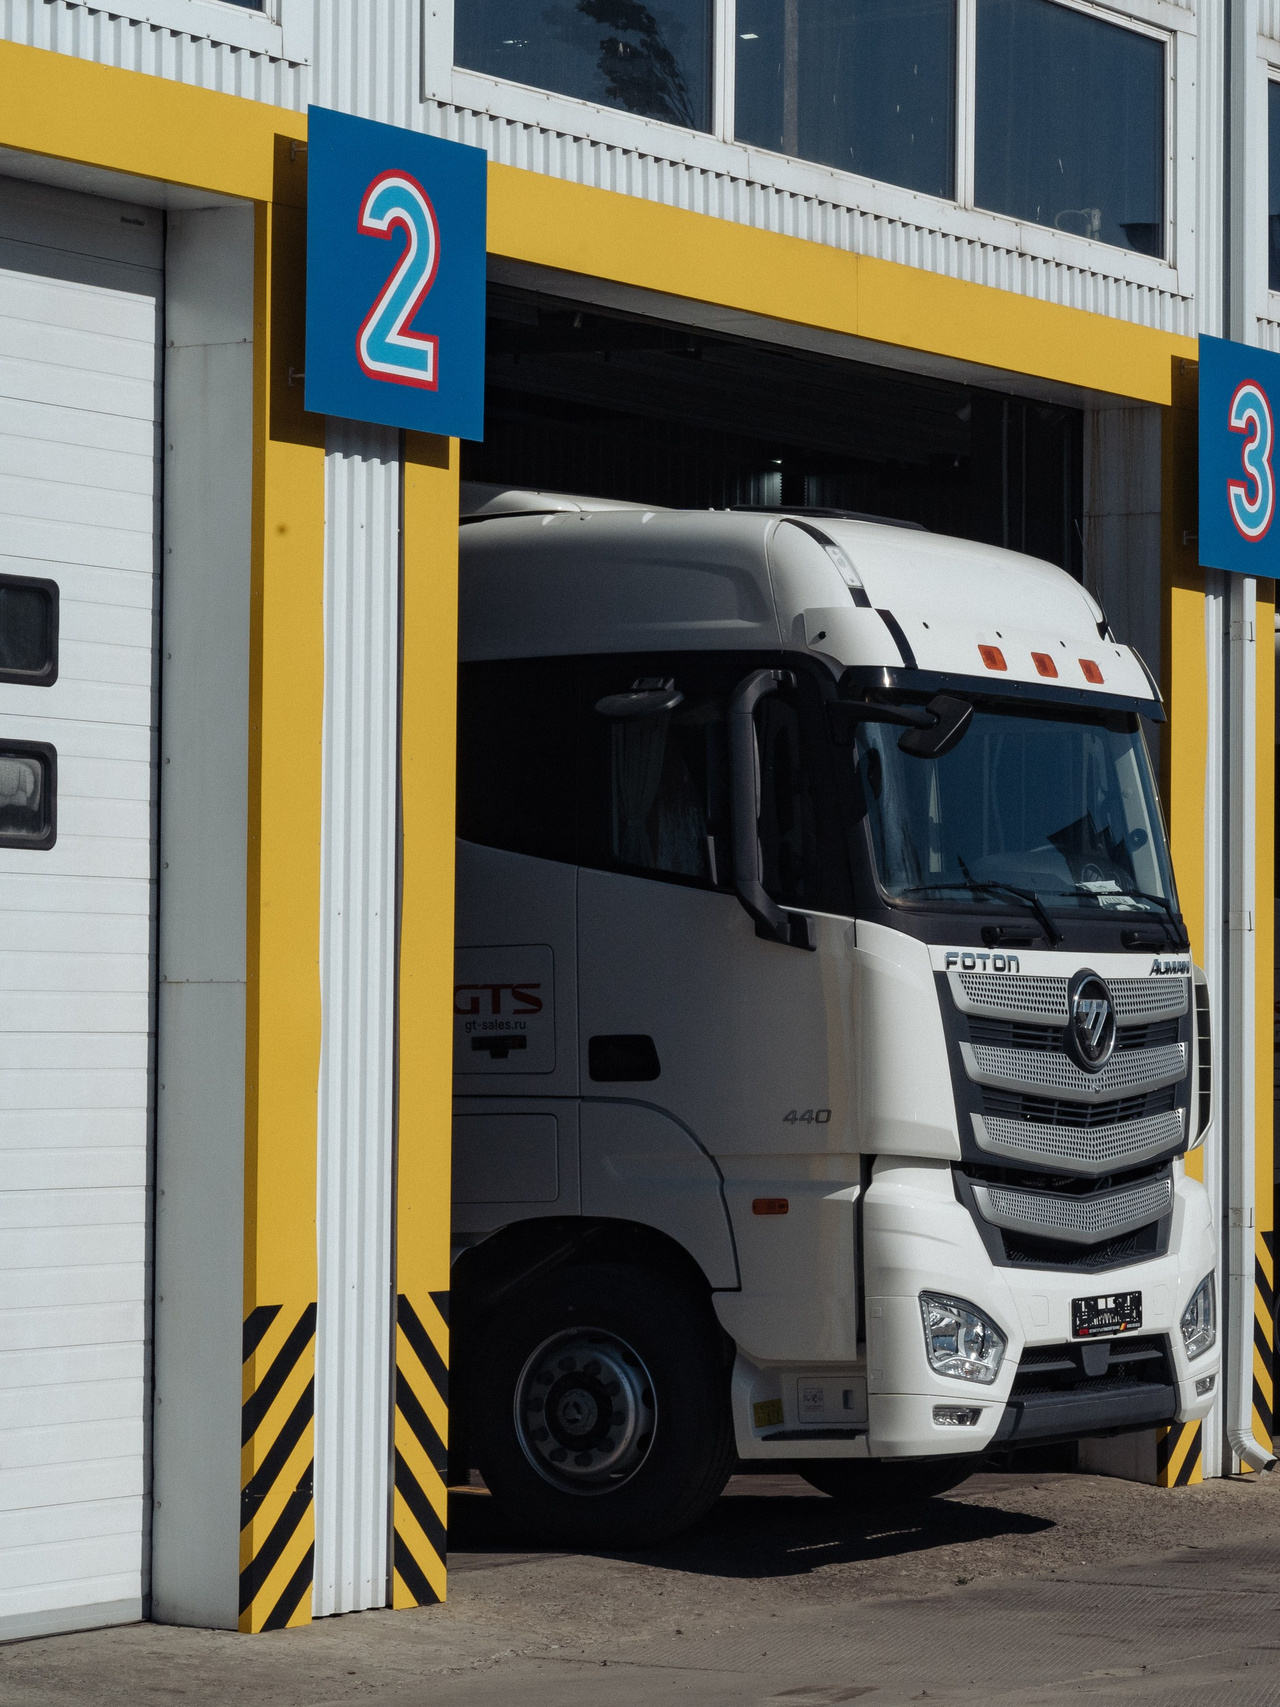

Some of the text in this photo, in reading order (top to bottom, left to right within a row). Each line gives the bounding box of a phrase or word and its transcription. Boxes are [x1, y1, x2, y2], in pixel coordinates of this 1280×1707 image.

[355, 168, 441, 392] 2
[1227, 378, 1276, 543] 3
[944, 951, 1020, 973] FOTON
[453, 983, 543, 1015] GTS
[464, 1019, 527, 1033] gt-sales.ru
[782, 1109, 832, 1124] 440
